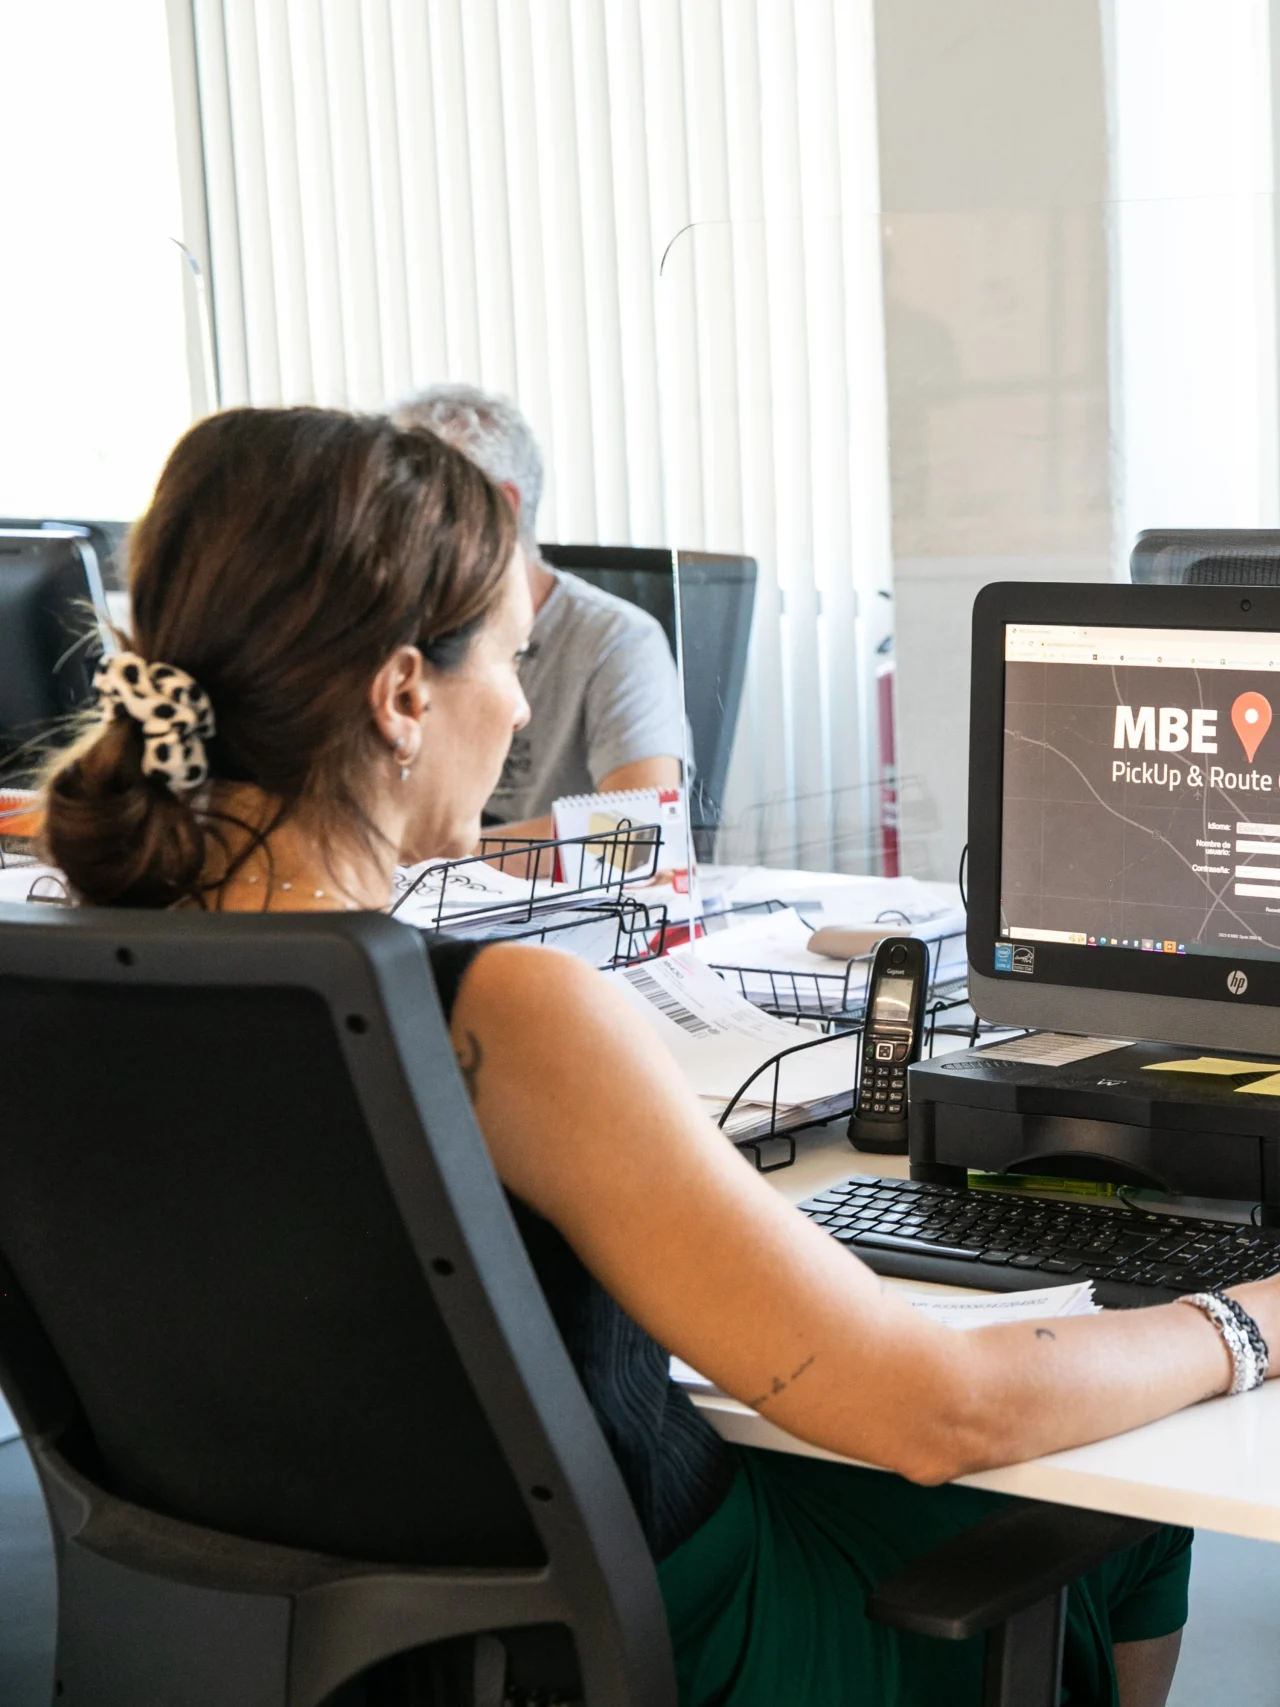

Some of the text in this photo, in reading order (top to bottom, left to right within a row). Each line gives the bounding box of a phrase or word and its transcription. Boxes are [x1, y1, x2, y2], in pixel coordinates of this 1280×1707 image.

[1113, 705, 1218, 754] MBE
[1112, 761, 1182, 791] PickUp
[1187, 765, 1204, 787] &
[1210, 766, 1272, 791] Route
[1196, 839, 1231, 849] Nombre de
[1230, 970, 1245, 995] hp
